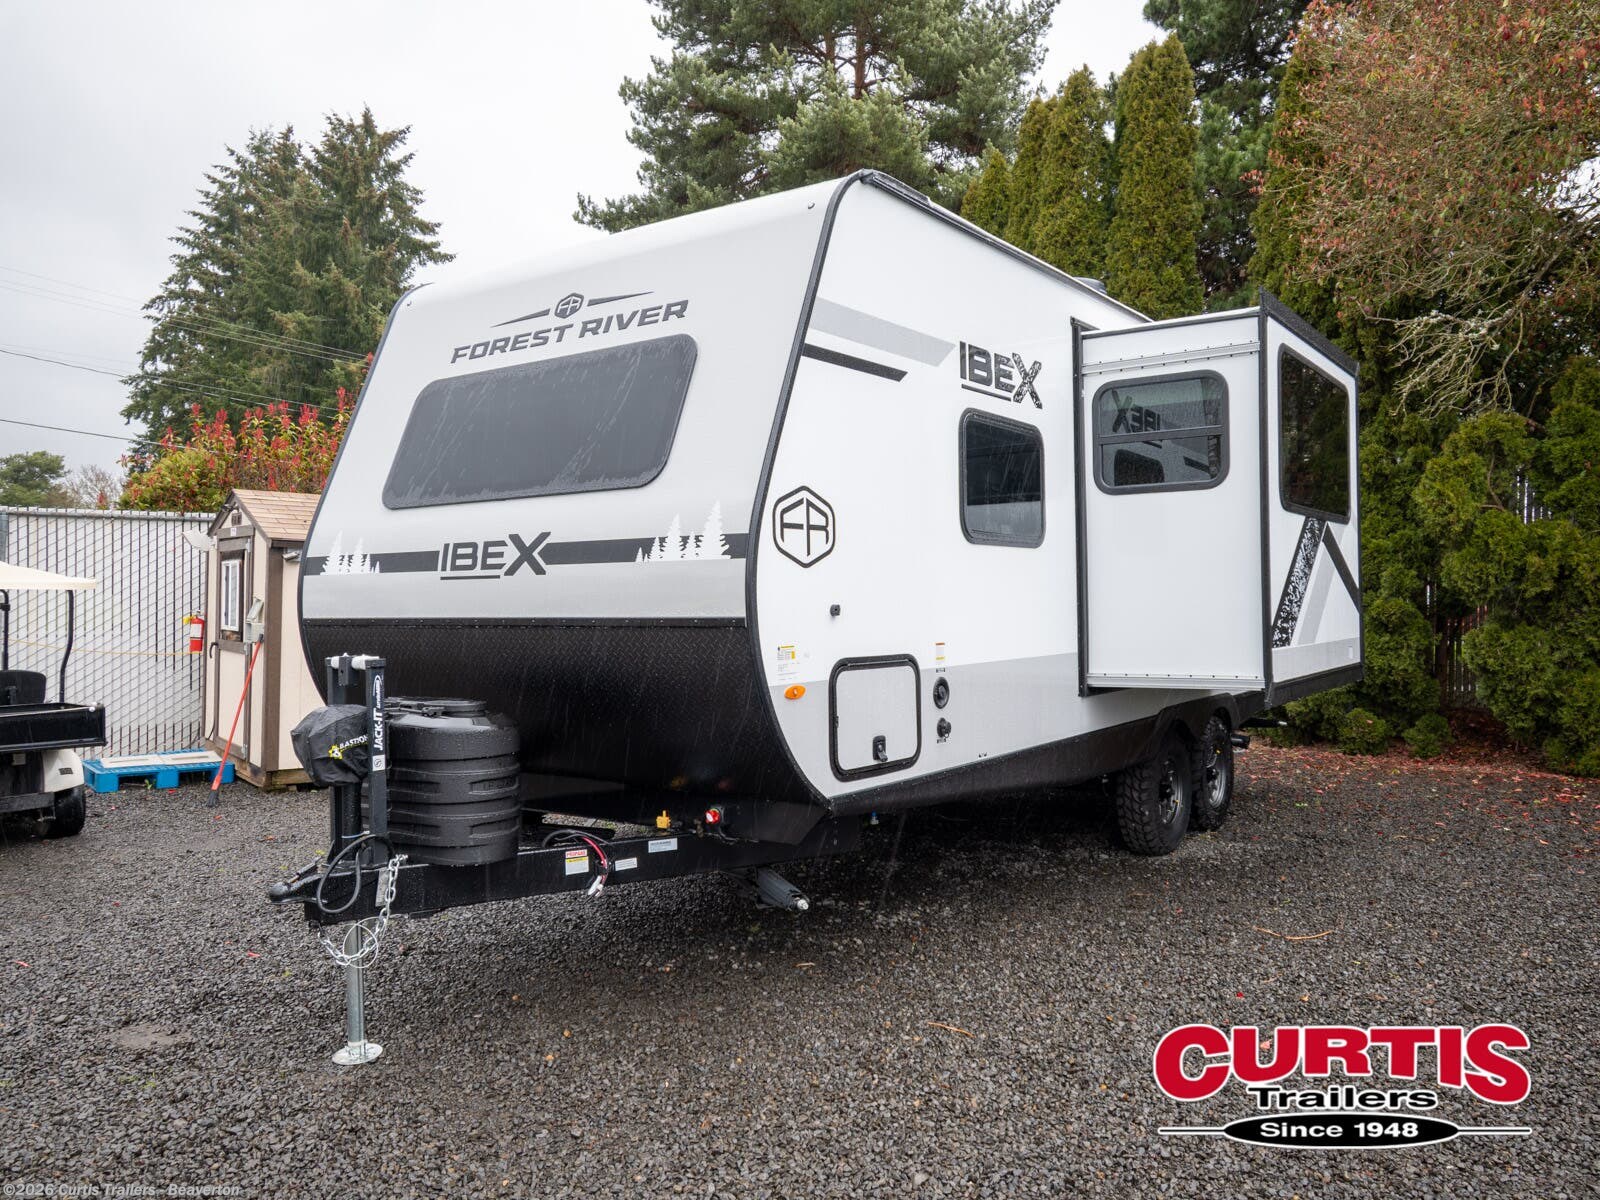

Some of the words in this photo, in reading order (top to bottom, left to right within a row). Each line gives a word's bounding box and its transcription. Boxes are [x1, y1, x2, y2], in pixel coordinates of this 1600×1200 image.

[450, 323, 574, 364] FOREST
[578, 299, 689, 338] RIVER
[960, 340, 1043, 409] IBEX
[440, 531, 551, 577] IBEX
[373, 707, 383, 751] JACK-IT
